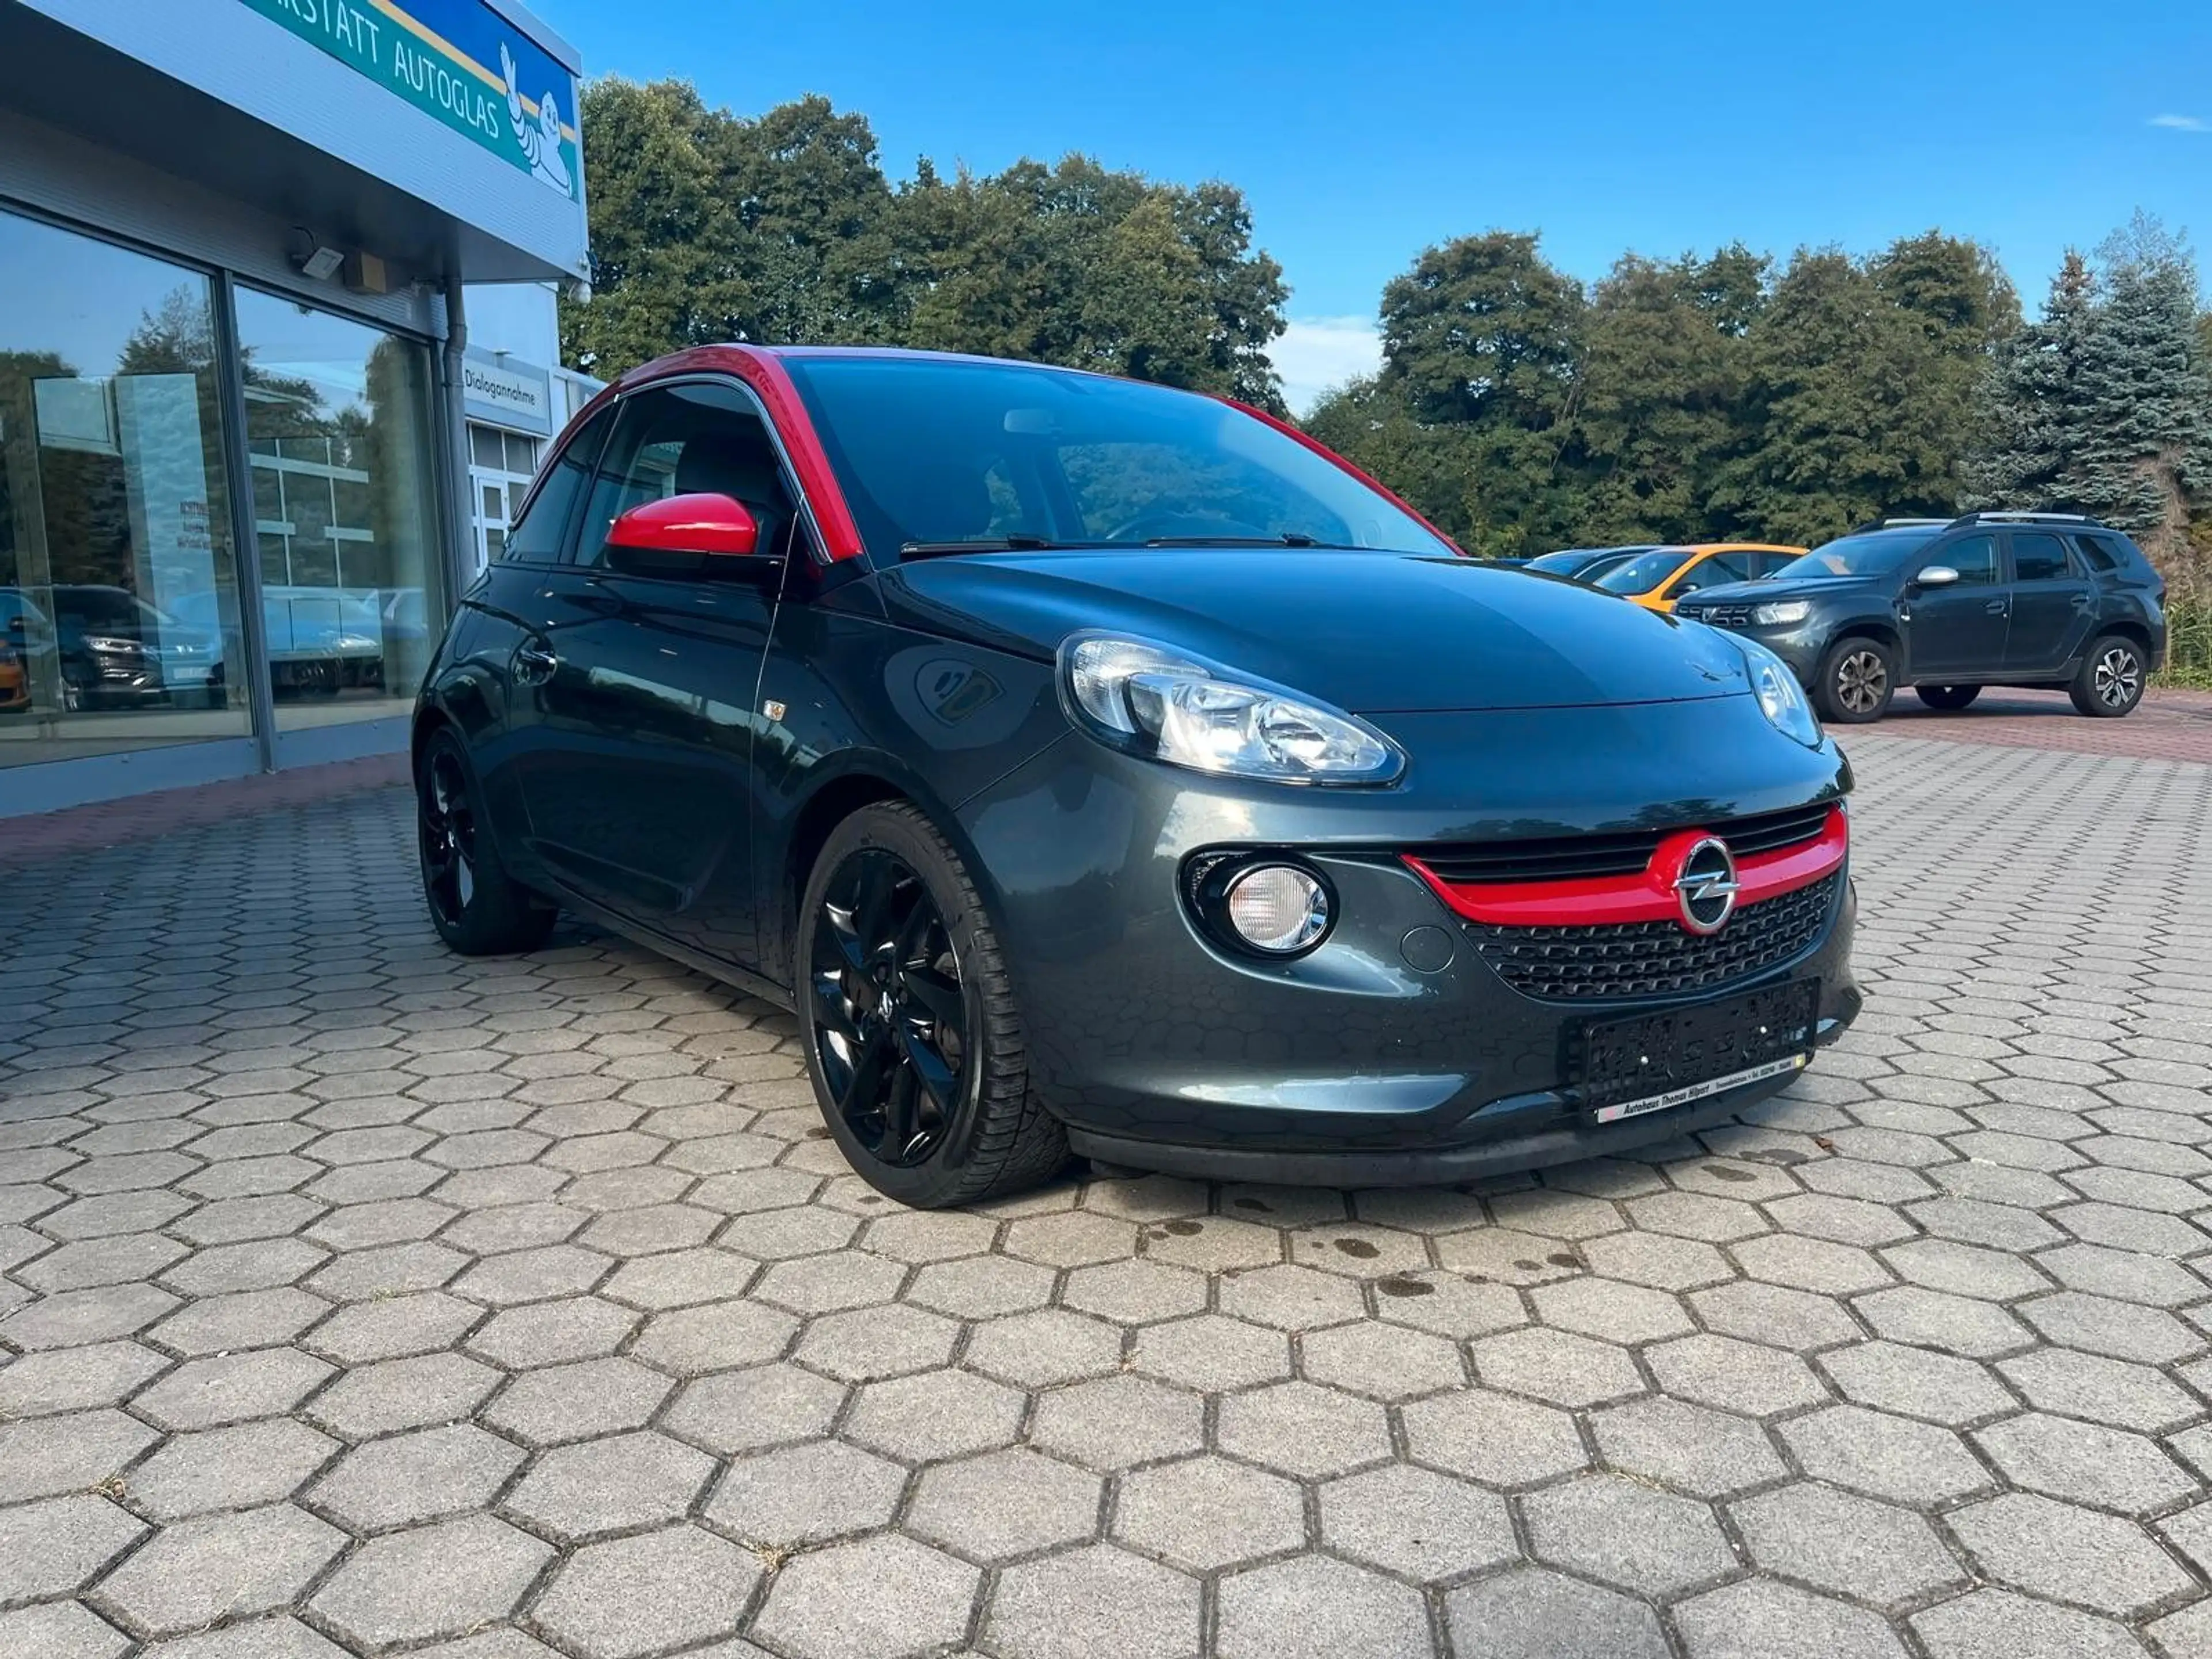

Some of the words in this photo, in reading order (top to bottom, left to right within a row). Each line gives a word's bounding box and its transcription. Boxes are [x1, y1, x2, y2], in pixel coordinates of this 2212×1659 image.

[278, 0, 380, 64] STATT
[394, 40, 499, 139] AUTOGLAS
[465, 369, 536, 406] Dialogannahme
[1623, 1100, 1660, 1115] Autohaus
